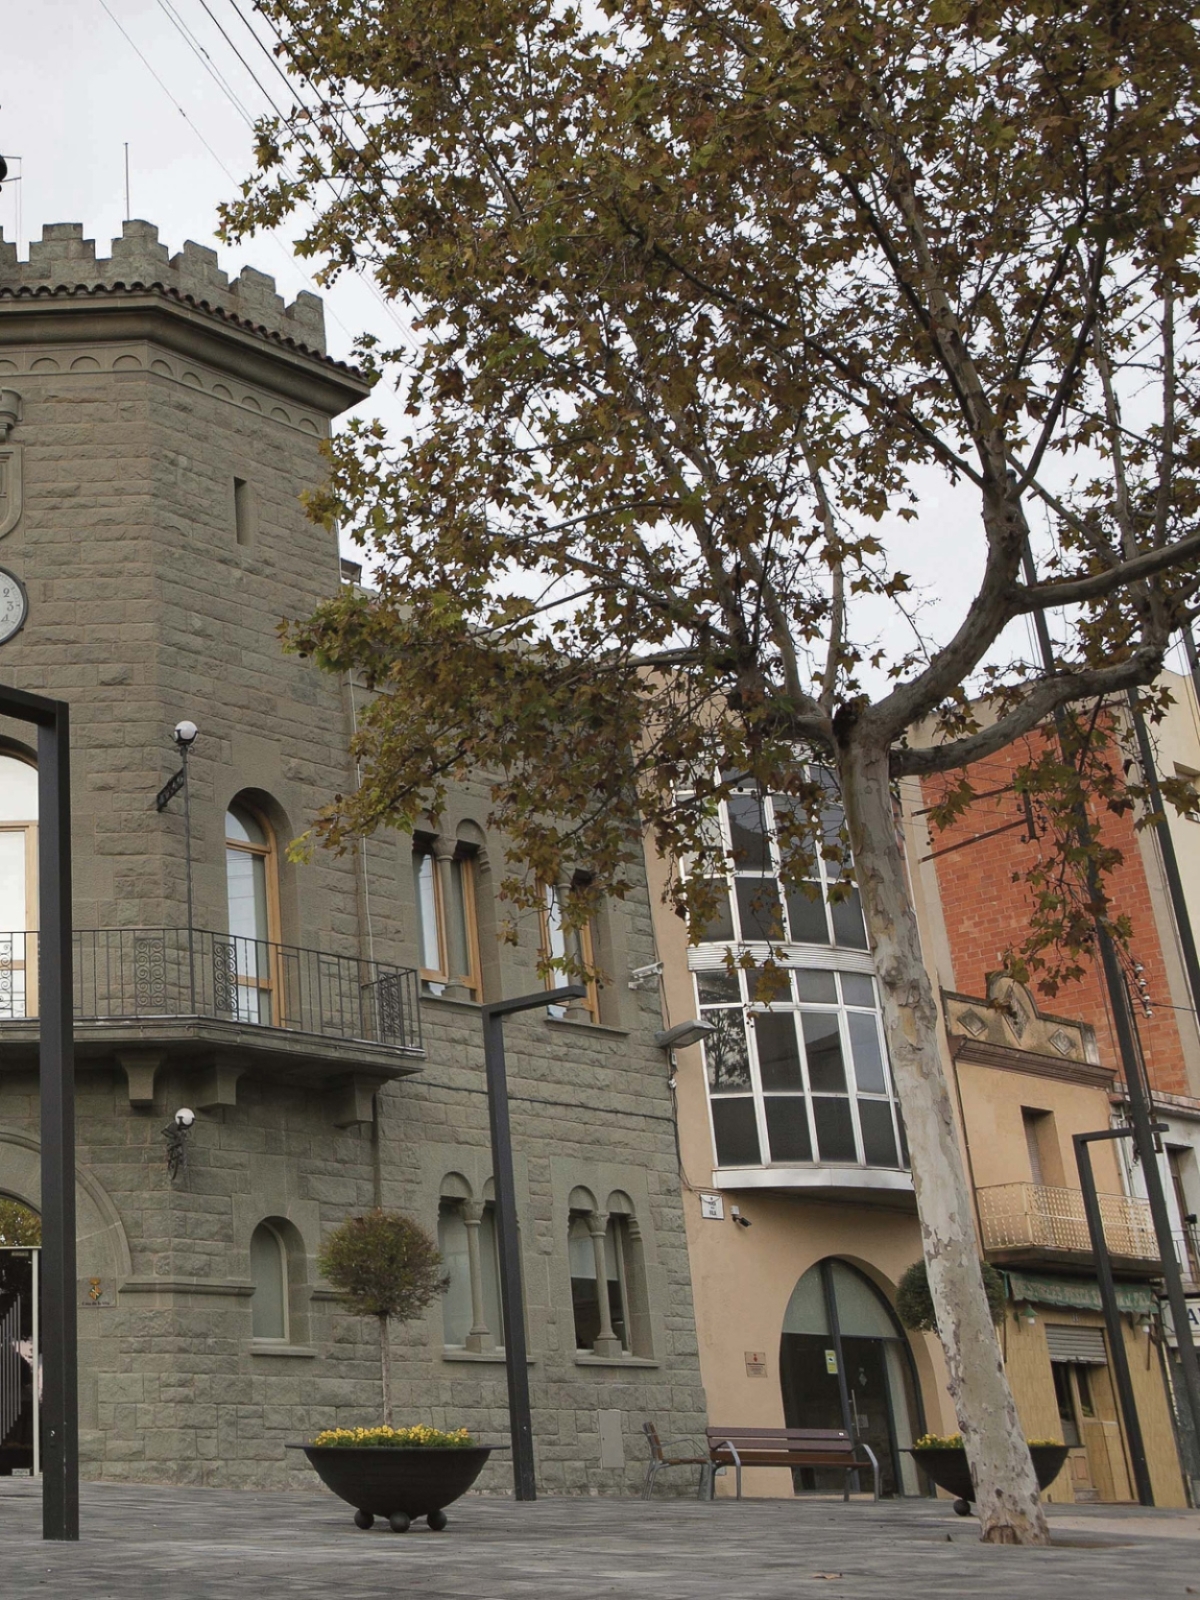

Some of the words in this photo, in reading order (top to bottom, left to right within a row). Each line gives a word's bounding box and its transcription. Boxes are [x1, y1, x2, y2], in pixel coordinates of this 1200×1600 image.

[3, 588, 10, 598] 2
[7, 601, 14, 611] 3
[1, 614, 9, 622] 4
